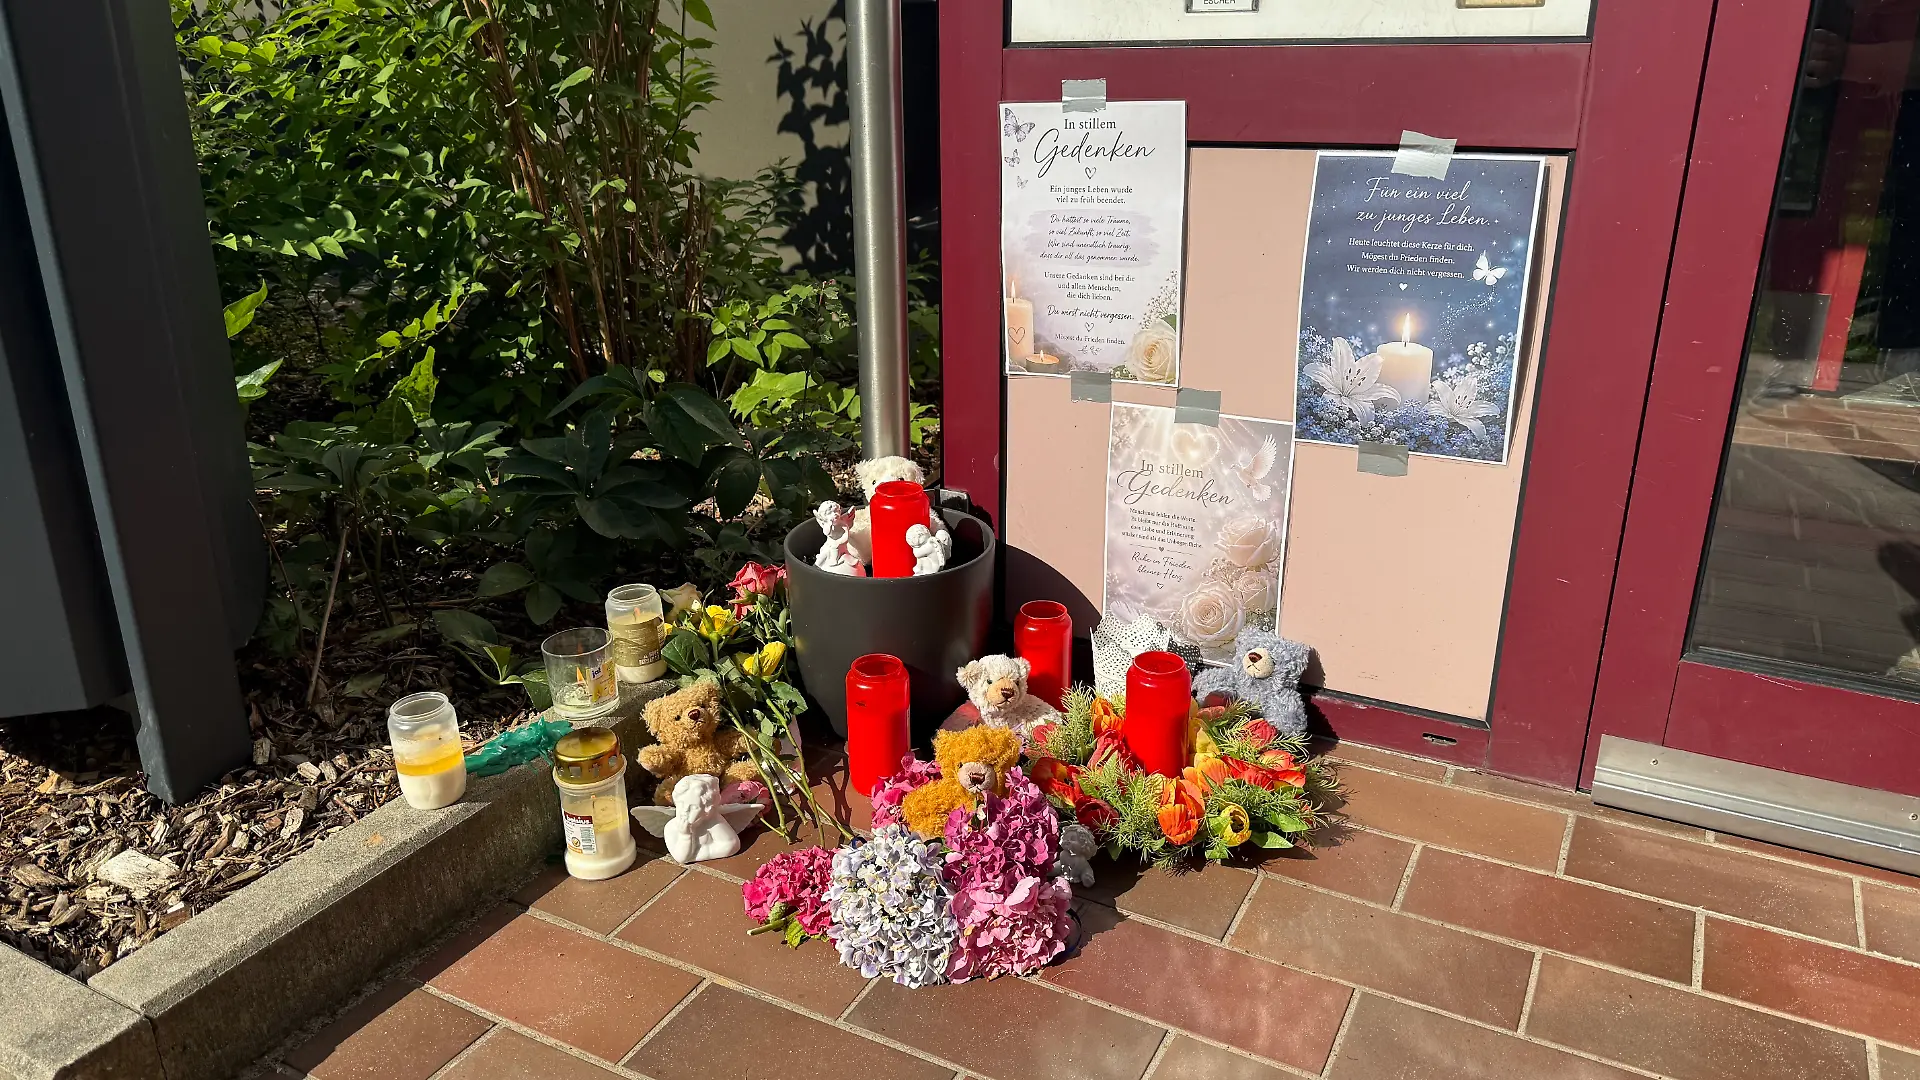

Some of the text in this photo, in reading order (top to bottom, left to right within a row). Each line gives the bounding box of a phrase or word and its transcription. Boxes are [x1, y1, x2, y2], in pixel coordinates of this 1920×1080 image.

[1064, 118, 1116, 129] In stillem
[1034, 128, 1155, 178] Gedenken
[1063, 186, 1086, 194] junges
[1405, 187, 1432, 199] ein
[1437, 180, 1470, 200] viel
[1050, 214, 1061, 223] Du
[1357, 203, 1490, 233] zu junges Leben.
[1104, 228, 1115, 236] viel
[1349, 238, 1475, 251] Heute leuchtet diese Kerze für dich.
[1362, 252, 1455, 264] Mögest du Frieden finden.
[1066, 272, 1098, 280] Gedanken
[1362, 266, 1388, 274] werden
[1390, 266, 1406, 275] dich
[1407, 268, 1425, 276] nicht
[1428, 270, 1465, 279] vergessen.
[1088, 284, 1122, 292] Menschen,
[1047, 304, 1135, 324] Du wirst nicht vergessen.
[1142, 460, 1203, 478] In stillem
[1116, 470, 1234, 508] Gedenken
